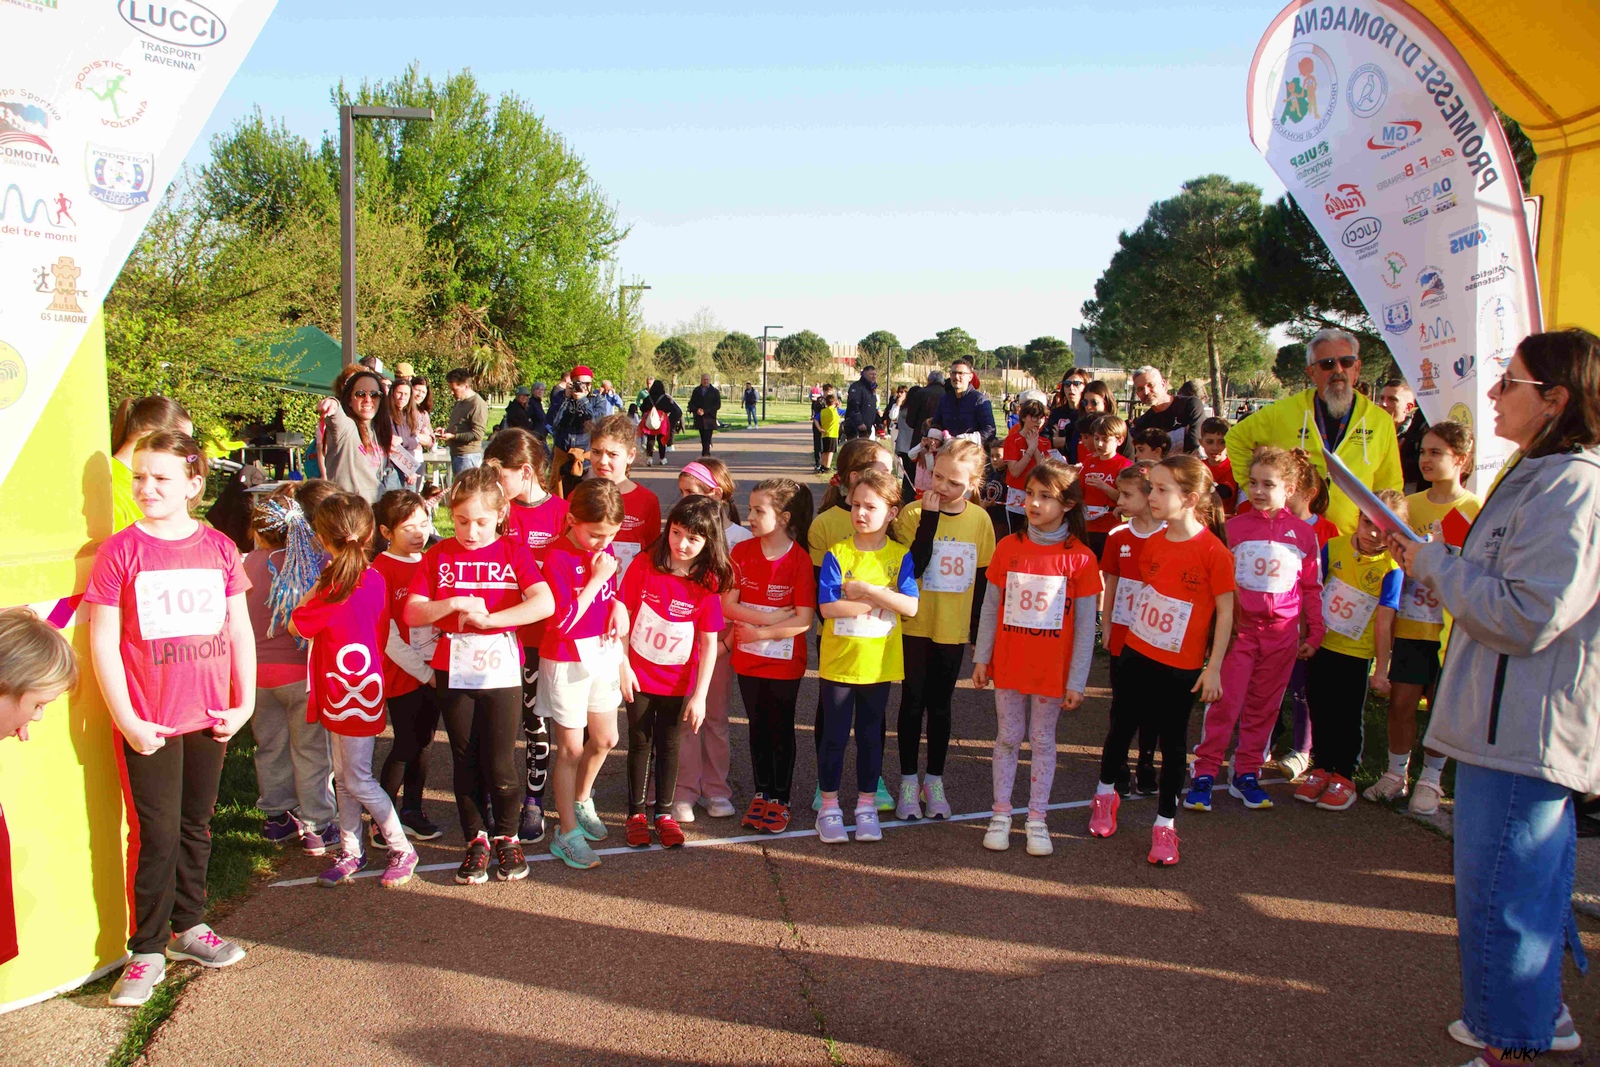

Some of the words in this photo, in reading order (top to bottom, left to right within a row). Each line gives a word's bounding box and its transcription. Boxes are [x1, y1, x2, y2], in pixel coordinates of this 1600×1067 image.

[130, 2, 216, 39] LUCCI
[140, 40, 202, 62] TRASPORTI
[144, 52, 196, 71] RAVENNA
[75, 60, 132, 90] PODISTICA
[20, 89, 61, 121] Sportivo
[101, 100, 148, 128] VOLTANA
[92, 150, 150, 164] PODISTICA
[91, 190, 147, 205] CALDERARA
[1, 224, 20, 235] dei
[23, 227, 41, 238] tre
[44, 232, 77, 243] monti
[40, 312, 52, 321] GS
[54, 313, 88, 324] LAMONE
[939, 556, 965, 576] 58
[1254, 557, 1281, 578] 92
[157, 588, 213, 615] 102
[1019, 589, 1049, 612] 85
[1329, 595, 1357, 620] 55
[1141, 602, 1174, 633] 108
[644, 626, 683, 653] 107
[472, 650, 501, 671] 56
